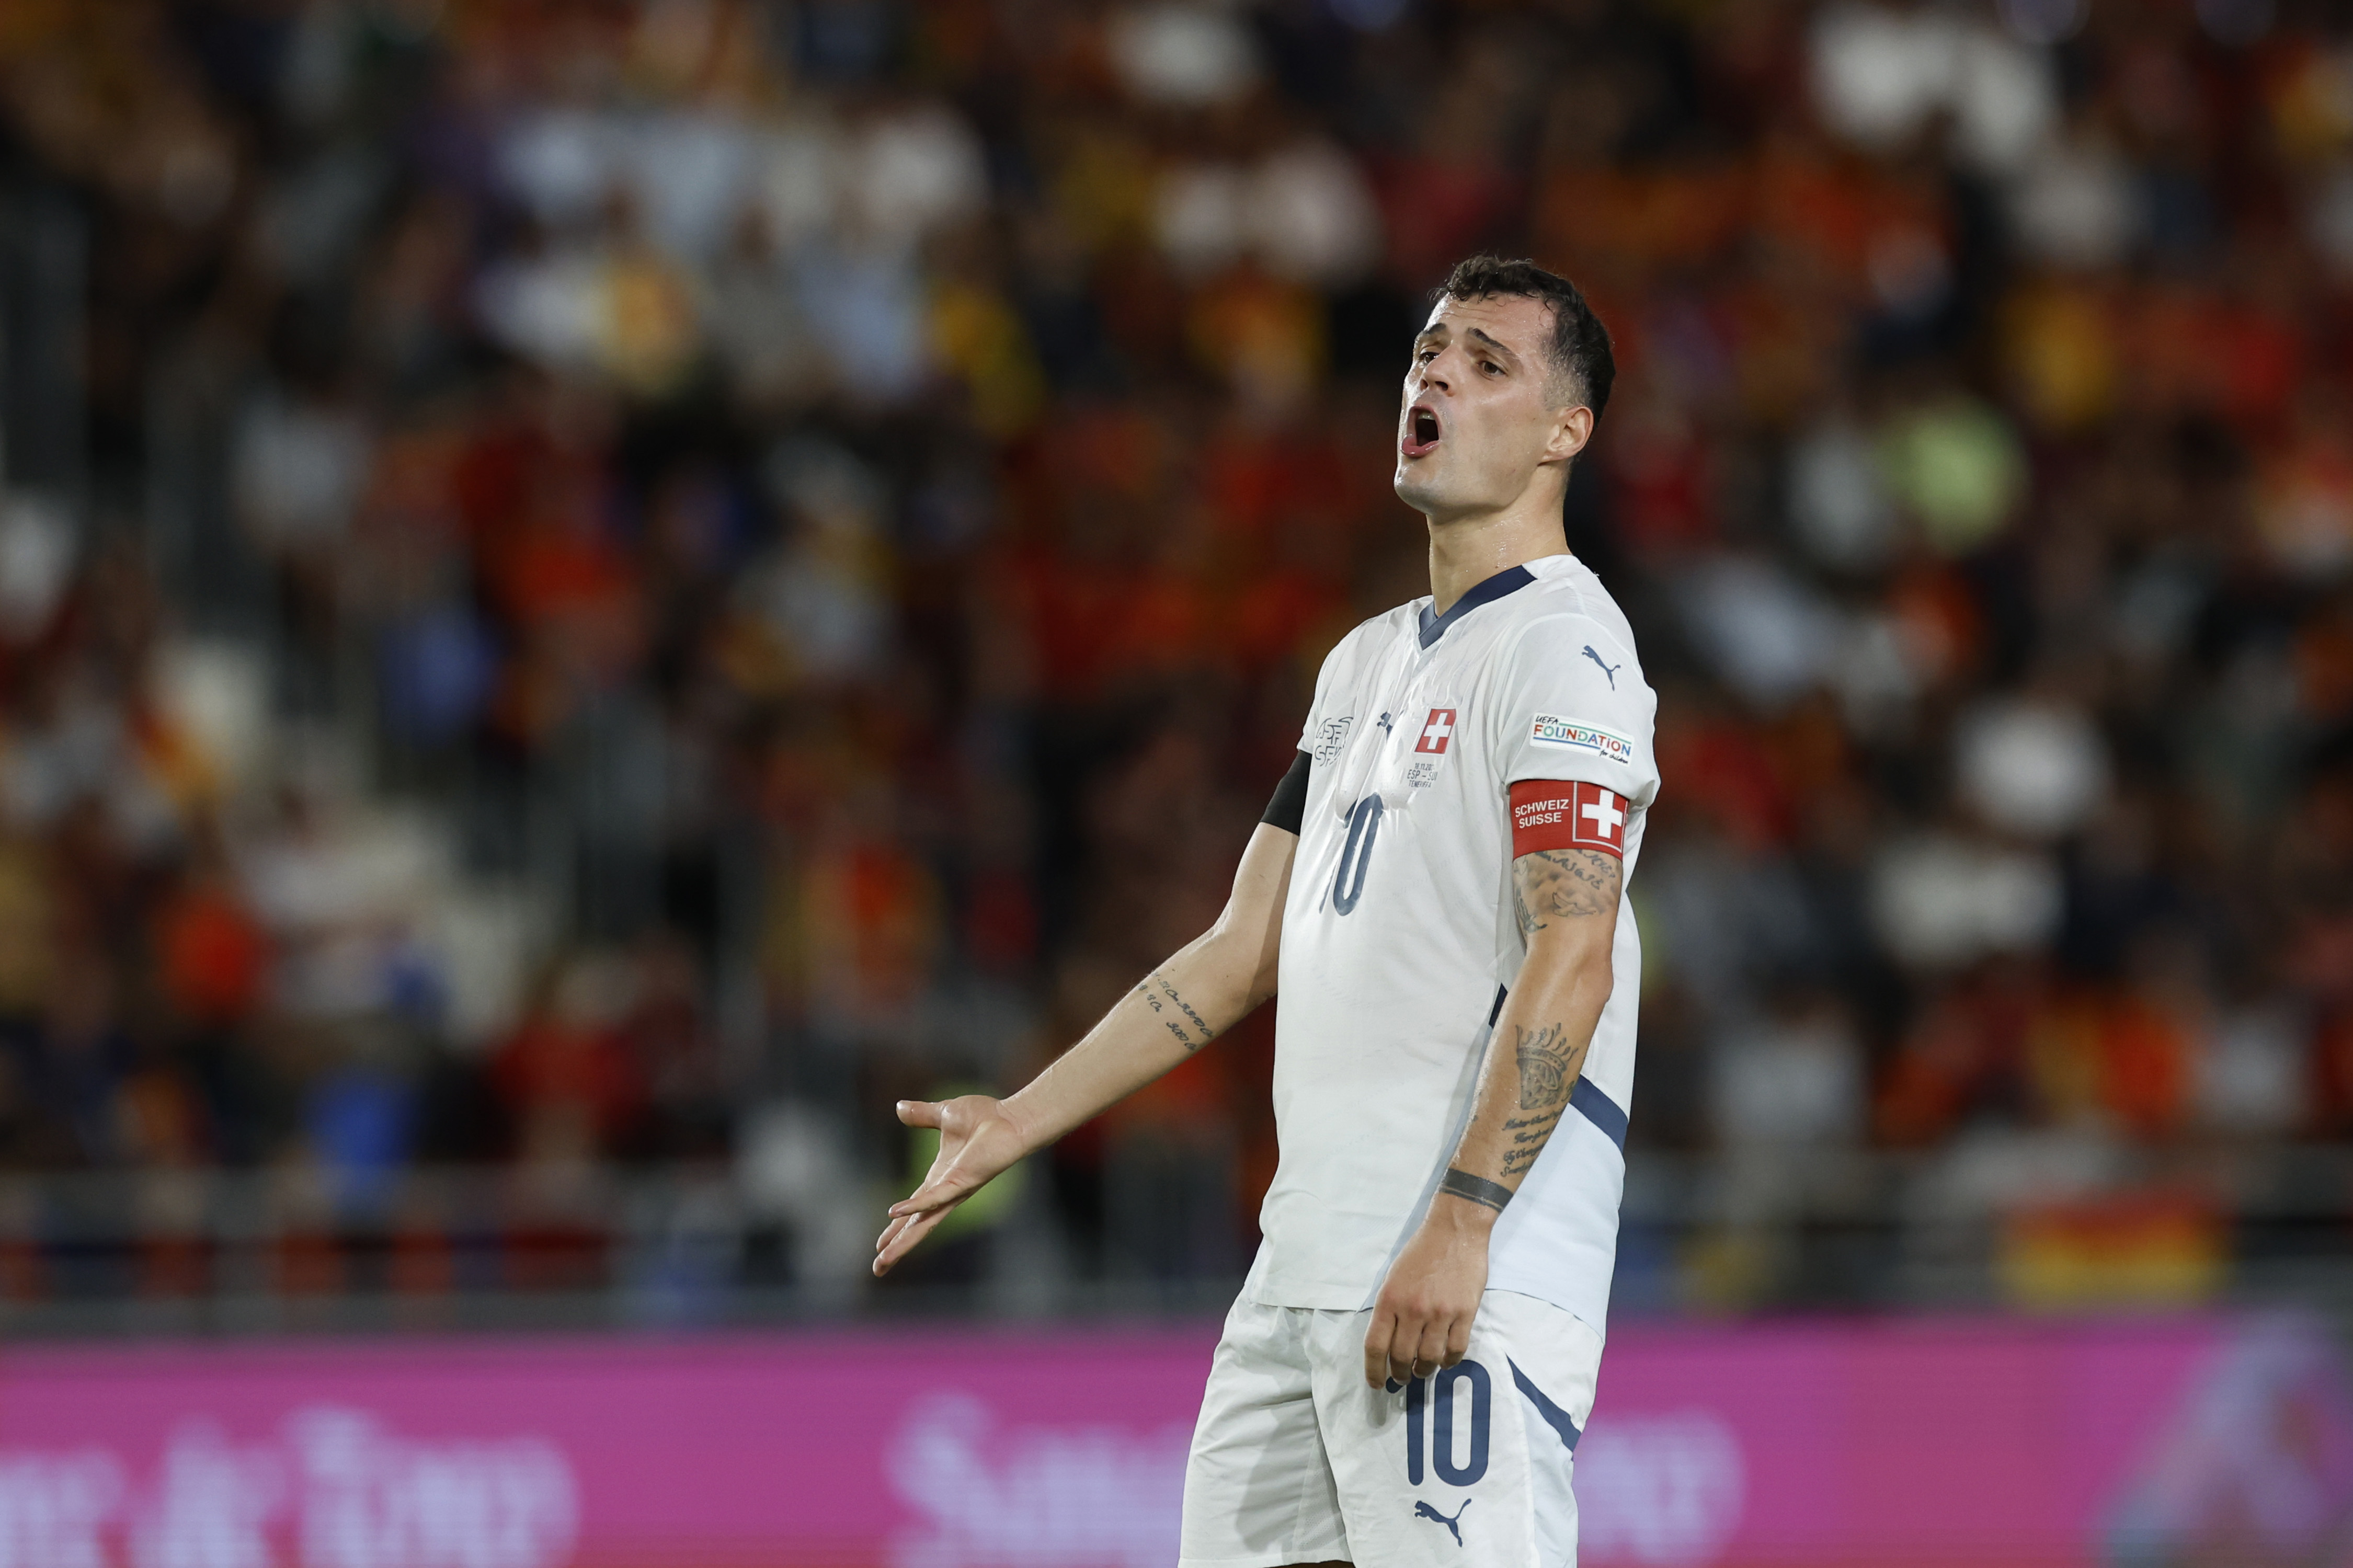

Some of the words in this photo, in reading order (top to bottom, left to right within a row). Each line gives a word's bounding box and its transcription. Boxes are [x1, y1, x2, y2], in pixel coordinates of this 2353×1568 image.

[1535, 715, 1559, 725] UEFA
[1609, 753, 1628, 764] children
[1407, 769, 1421, 779] ESP
[1427, 771, 1438, 781] SUI
[1515, 799, 1569, 818] SCHWEIZ
[1519, 811, 1562, 829] SUISSE
[1386, 1359, 1491, 1486] 10
